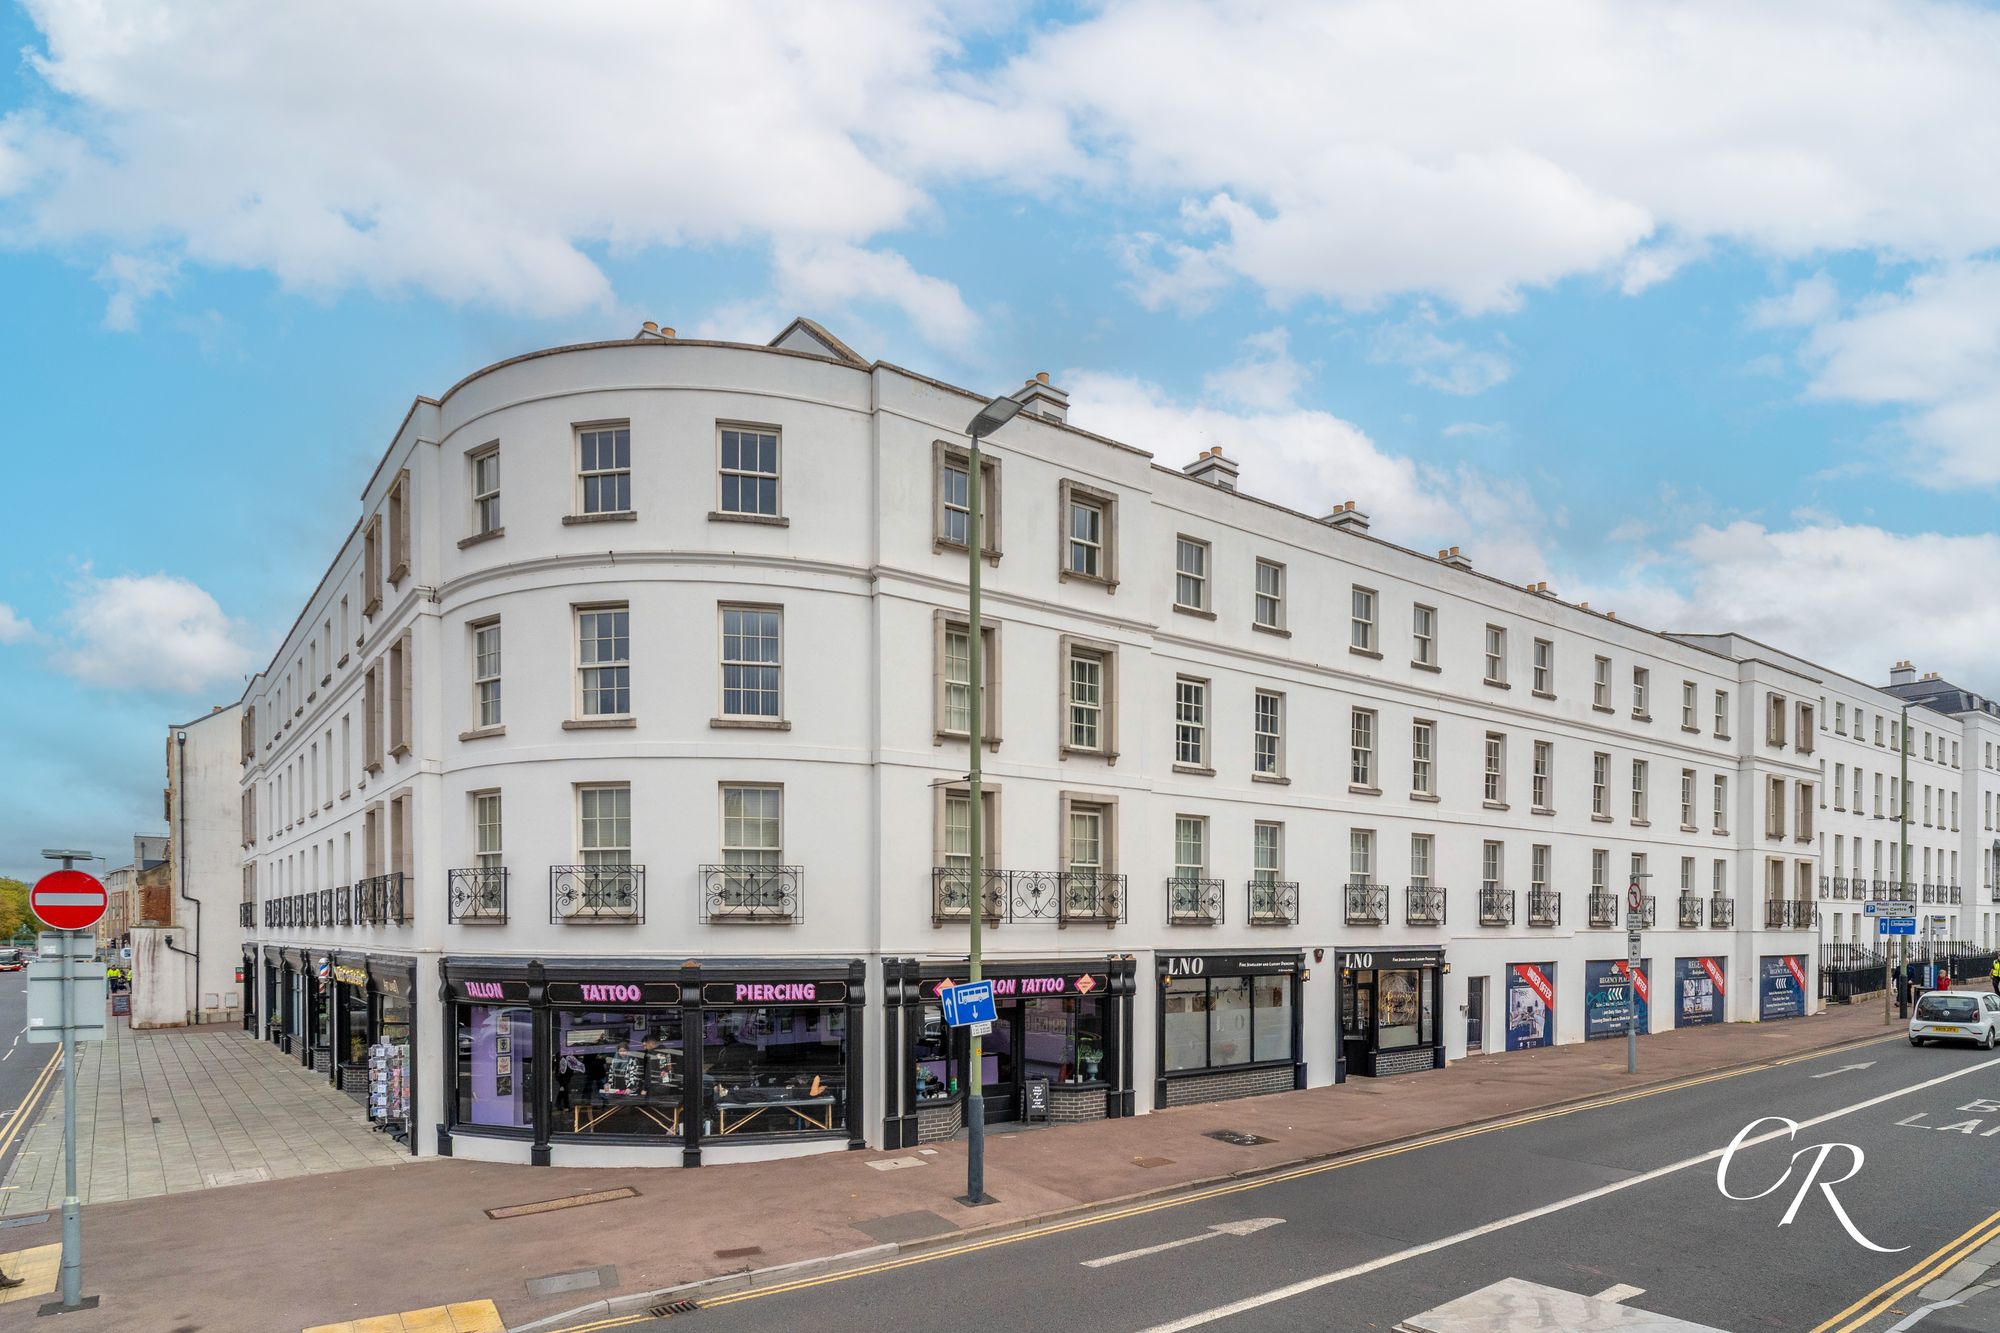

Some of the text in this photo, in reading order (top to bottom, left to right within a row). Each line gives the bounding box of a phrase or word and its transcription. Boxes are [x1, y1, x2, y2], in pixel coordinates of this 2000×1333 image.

[1168, 957, 1204, 975] LNO
[1345, 953, 1373, 969] LNO
[465, 981, 504, 999] TALLON
[736, 983, 816, 1001] PIERCING
[1021, 977, 1065, 994] TATTOO
[1526, 966, 1553, 1001] UNDER OFFER
[580, 984, 642, 1002] TATTOO
